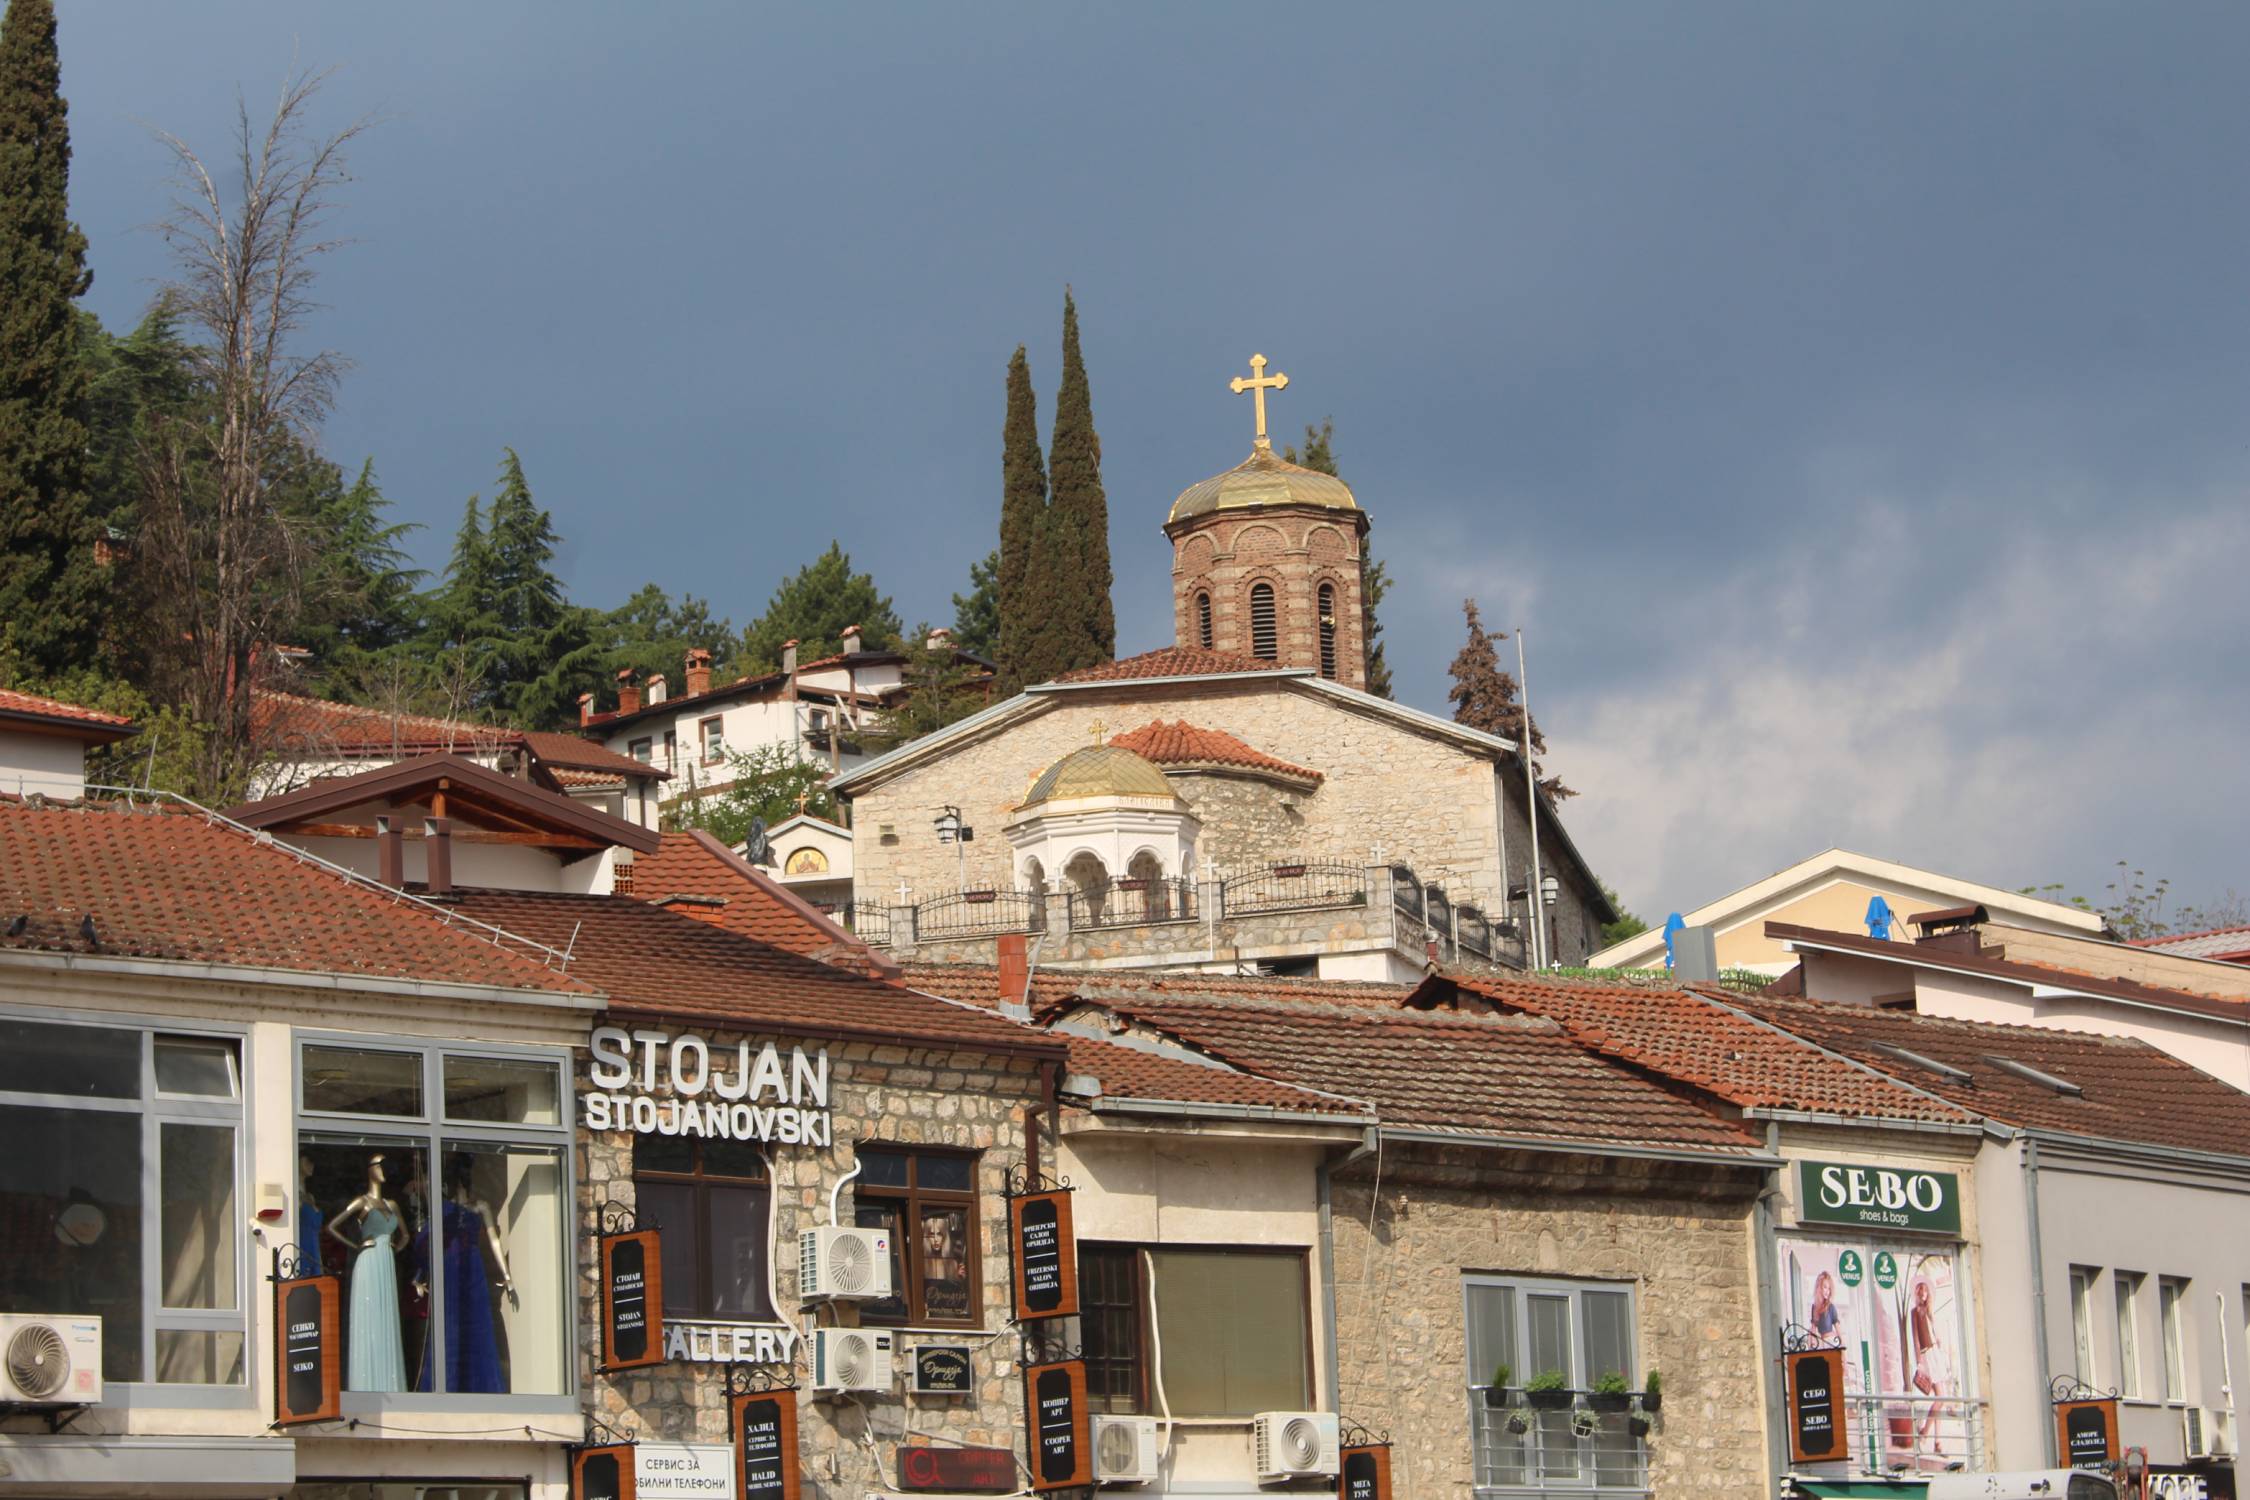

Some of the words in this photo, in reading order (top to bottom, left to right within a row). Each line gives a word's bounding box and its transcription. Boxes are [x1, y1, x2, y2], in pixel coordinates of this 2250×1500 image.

[591, 1026, 827, 1107] STOJAN
[585, 1092, 831, 1147] STOJANOVSKI
[1820, 1166, 1943, 1212] SEBO
[1859, 1209, 1881, 1221] shoes
[1882, 1211, 1889, 1222] &
[1890, 1211, 1909, 1226] bags
[1030, 1231, 1050, 1240] САЛОН
[1027, 1264, 1058, 1275] FRIZERSKI
[616, 1272, 641, 1284] СТОЈАН
[1032, 1273, 1052, 1282] SALON
[1841, 1272, 1860, 1280] VENUS
[618, 1311, 641, 1322] STOJAN
[663, 1325, 798, 1363] ALLERY
[293, 1361, 314, 1373] SEIKO
[1803, 1388, 1826, 1399] СЕБО
[1051, 1408, 1063, 1417] АРТ
[1805, 1415, 1828, 1425] SEBO
[748, 1422, 775, 1433] ХАЛИД
[1045, 1435, 1071, 1447] COOPER
[1052, 1445, 1065, 1455] ART
[645, 1458, 685, 1471] СЕРВИС
[687, 1459, 701, 1471] ЗА
[751, 1470, 776, 1481] HALID
[635, 1477, 672, 1489] БИЛНИ
[674, 1478, 726, 1490] ТЕЛЕФОНИ
[1352, 1480, 1371, 1489] МЕГА
[1353, 1489, 1371, 1499] ТУРС
